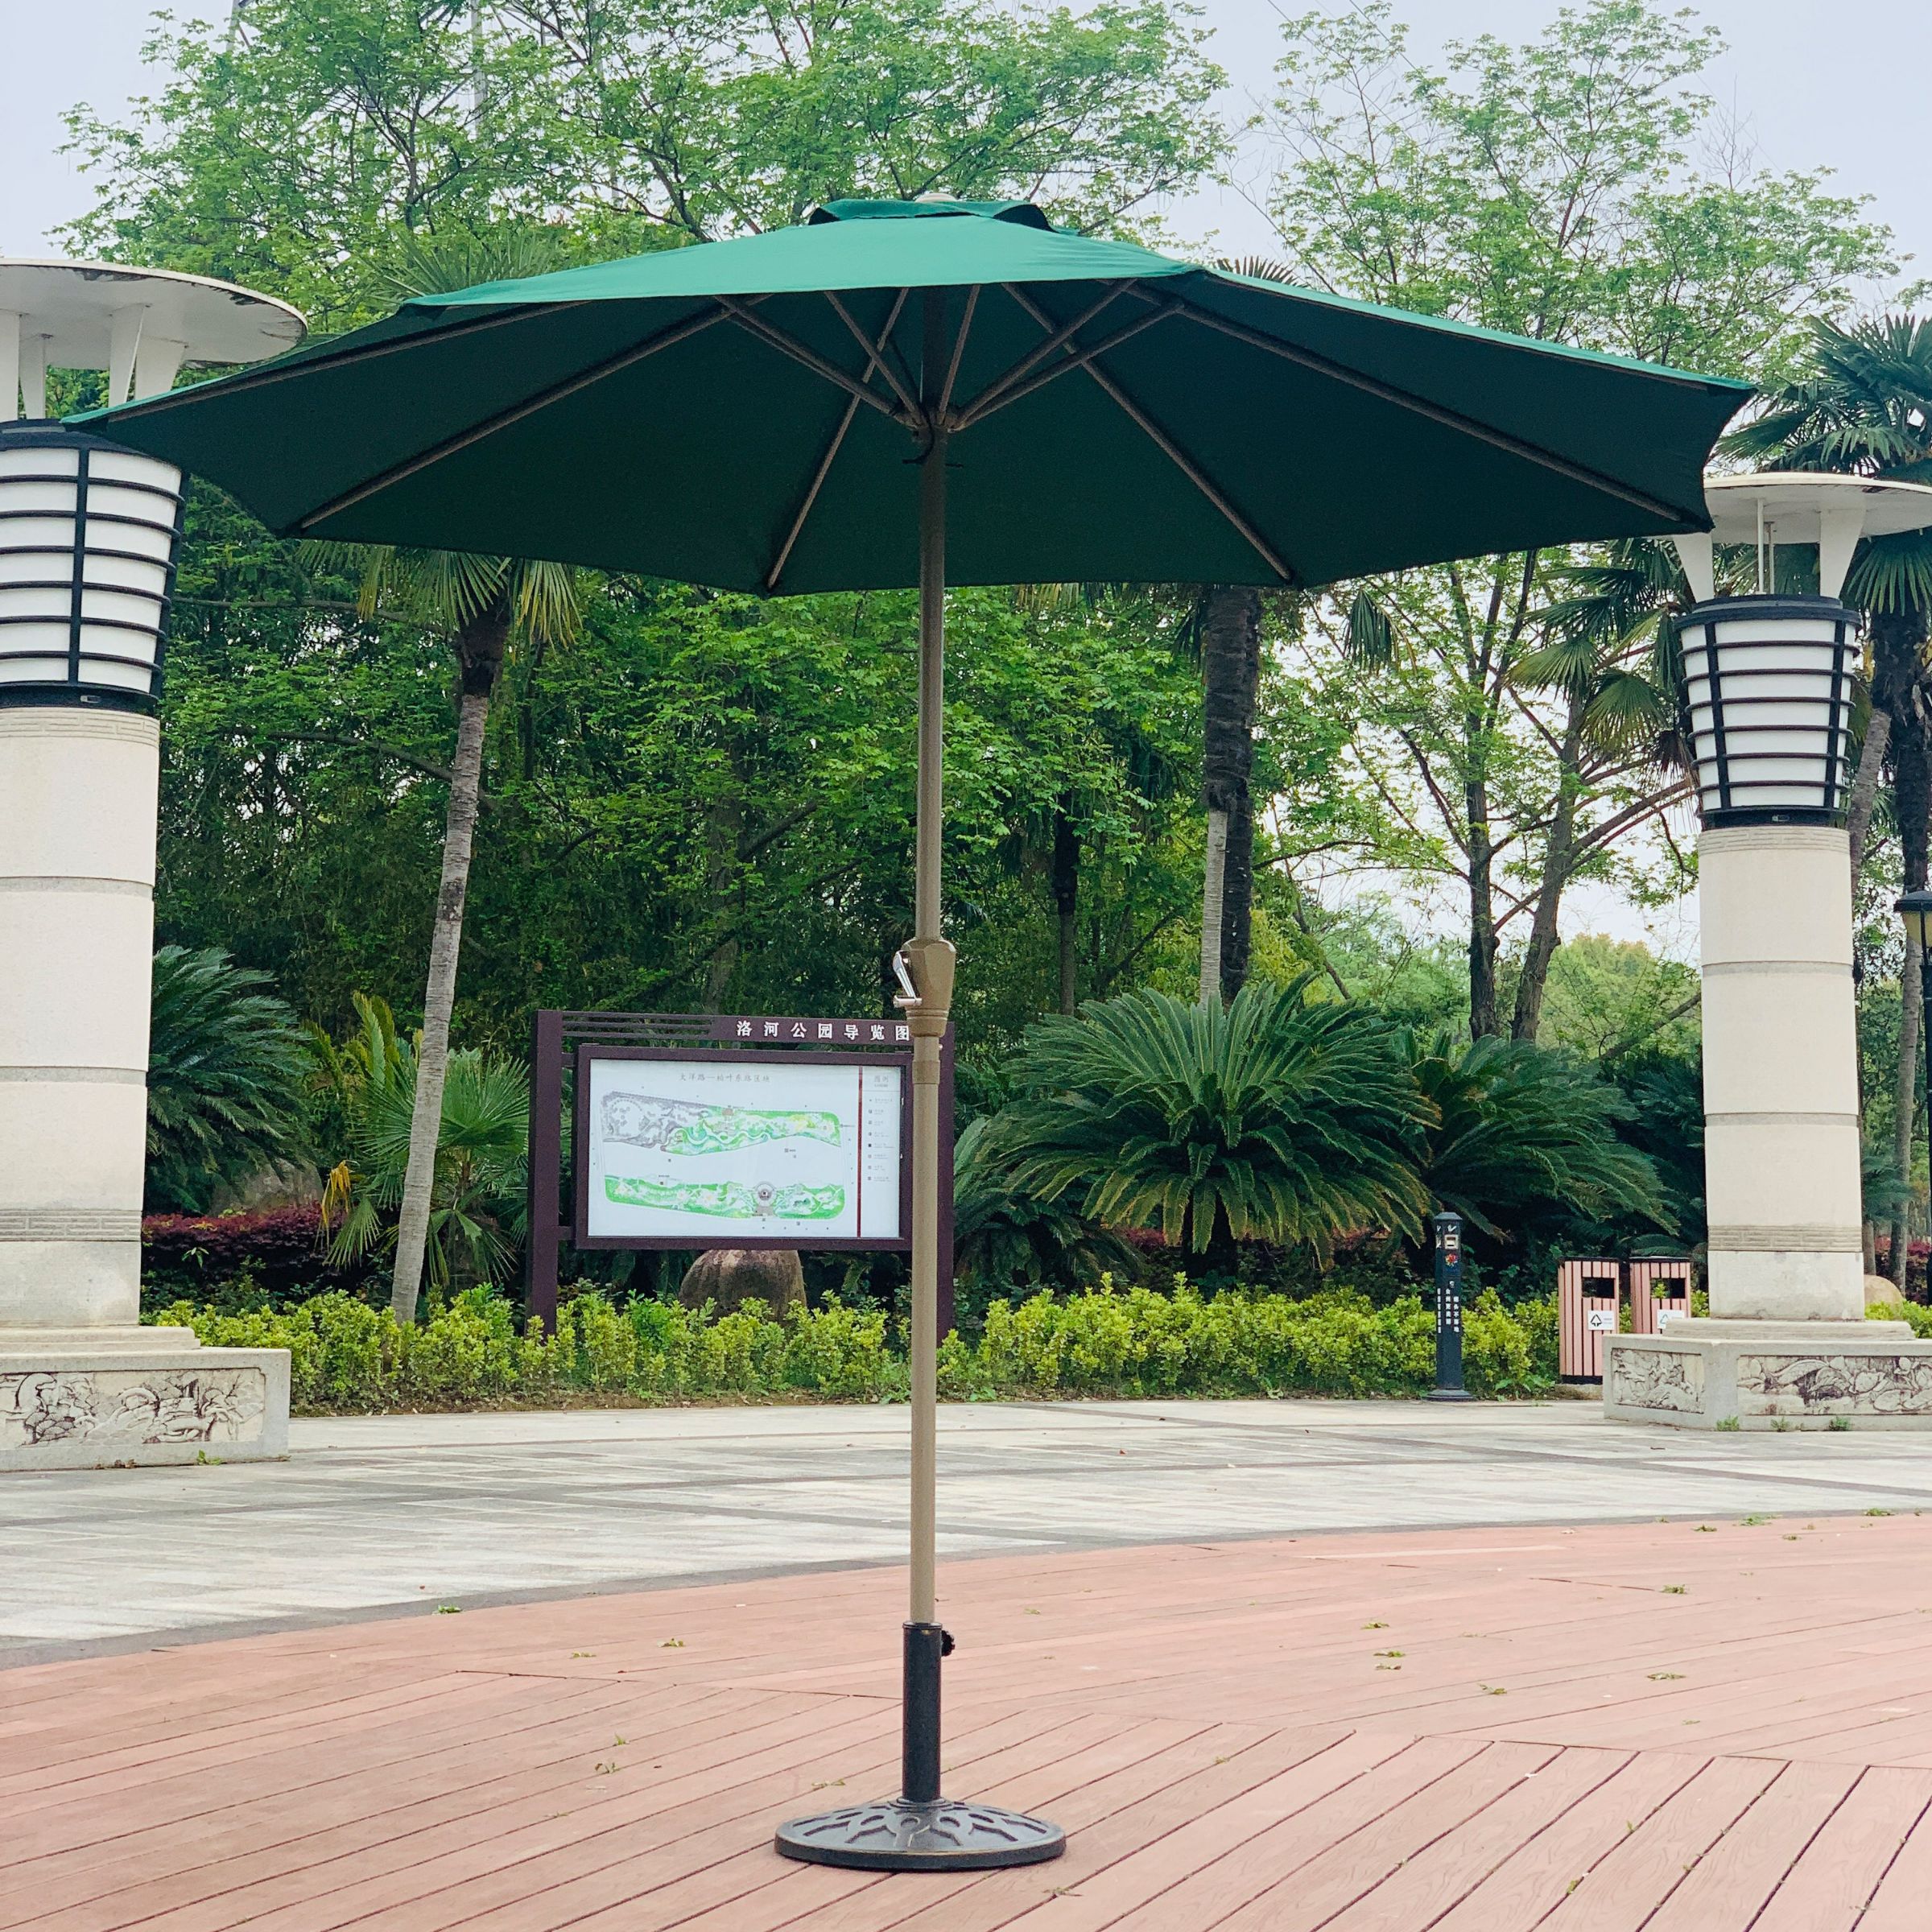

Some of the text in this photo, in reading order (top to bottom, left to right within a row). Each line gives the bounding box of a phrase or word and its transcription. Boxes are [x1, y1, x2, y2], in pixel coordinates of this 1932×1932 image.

[737, 1020, 910, 1041] 洛河公园导览图
